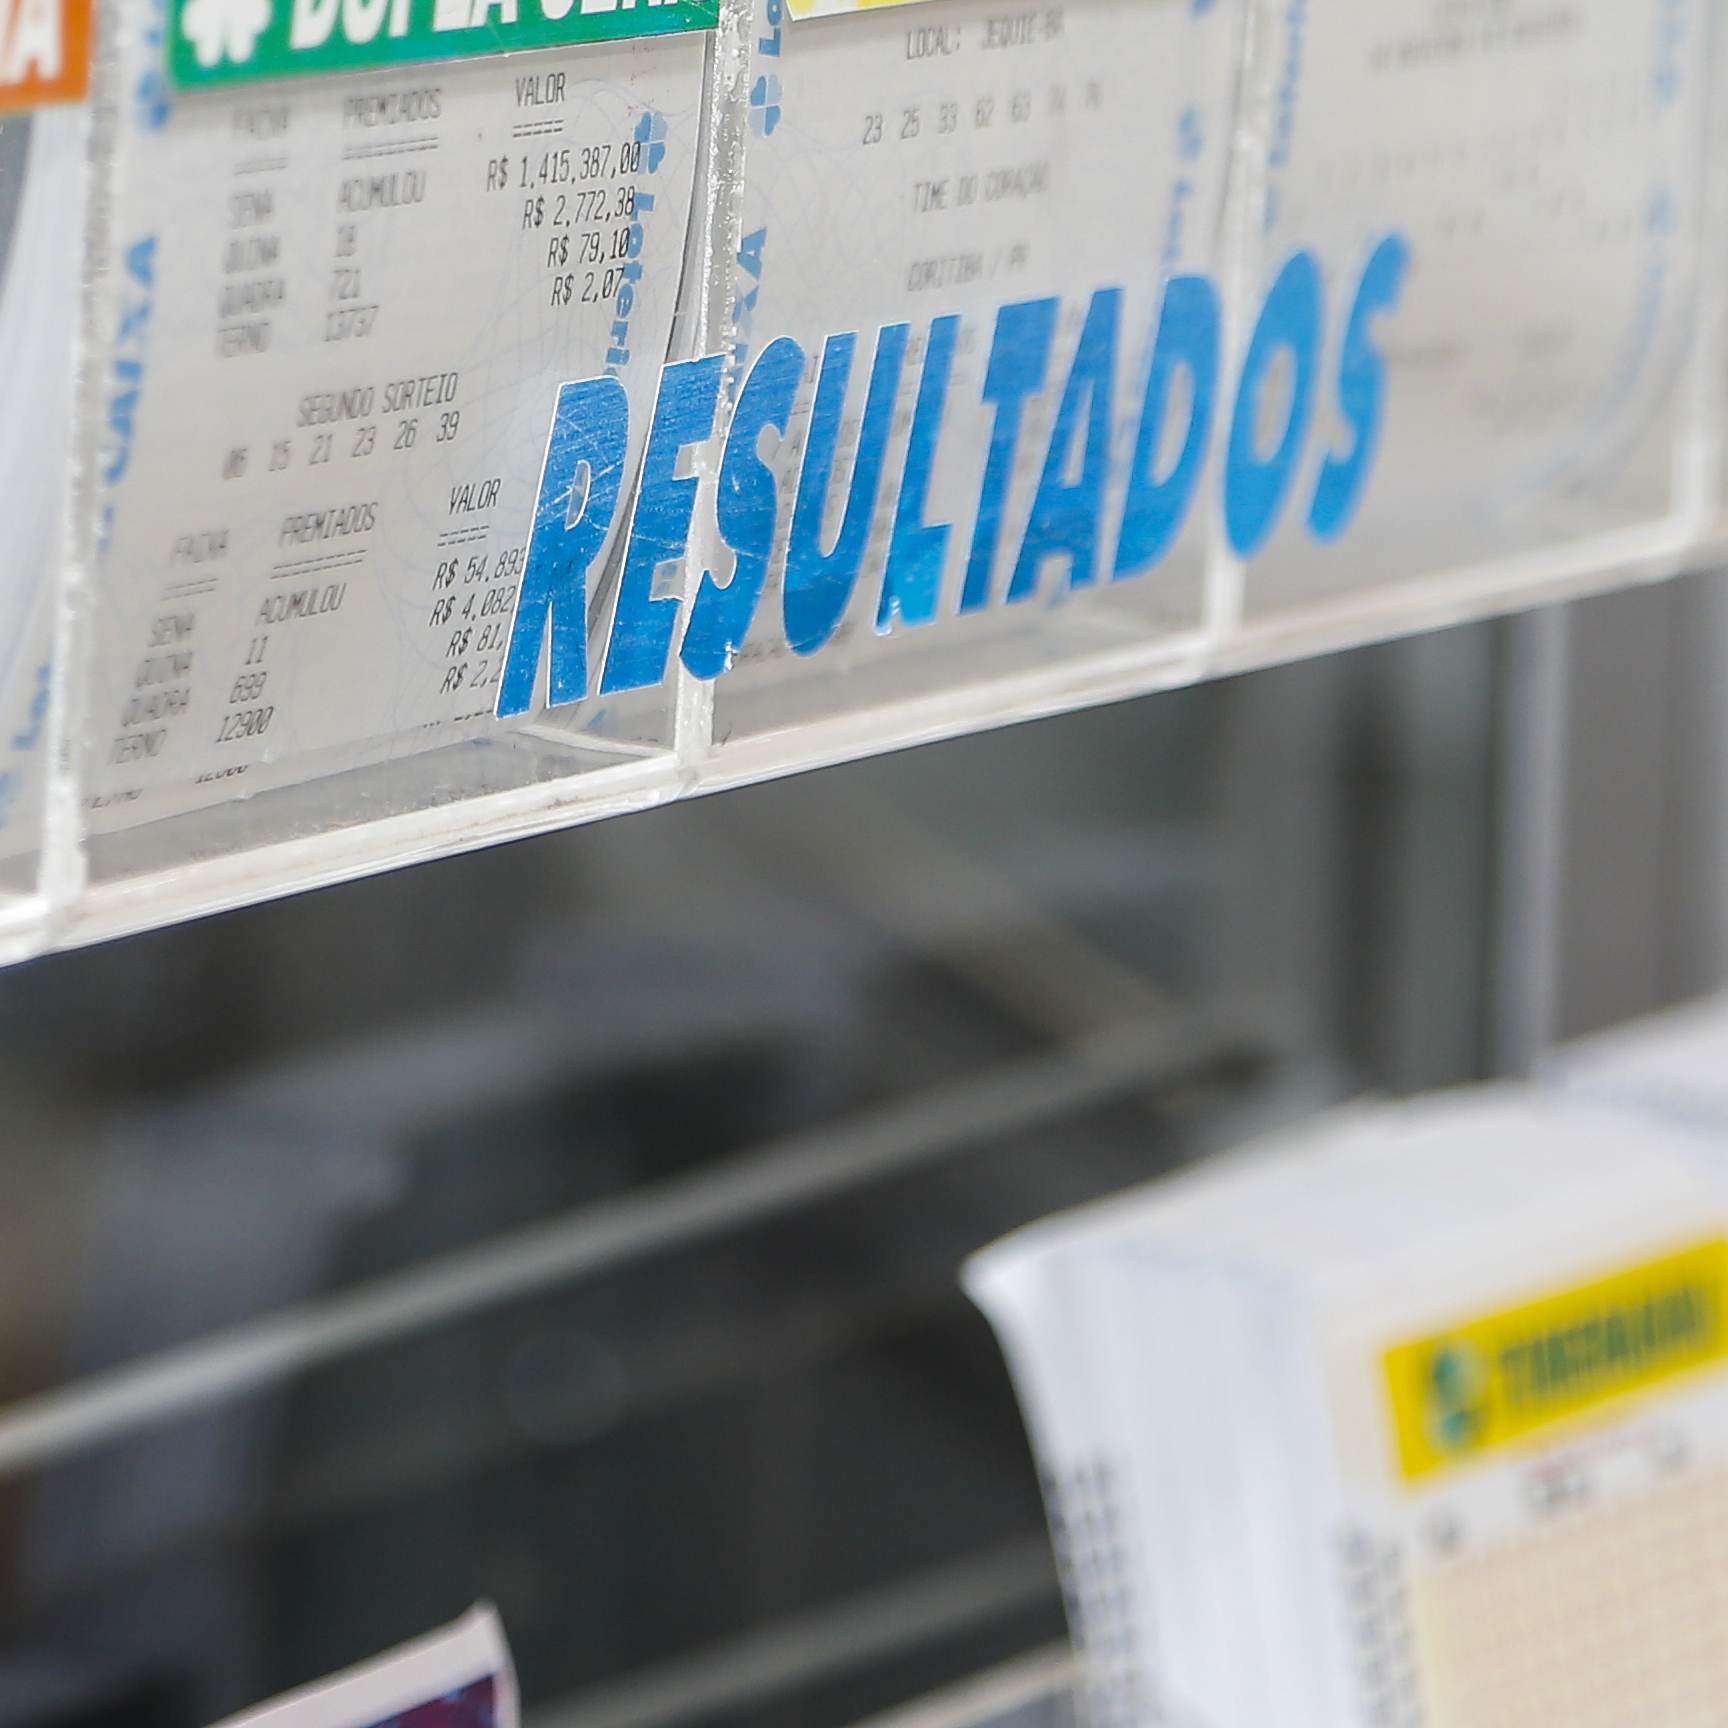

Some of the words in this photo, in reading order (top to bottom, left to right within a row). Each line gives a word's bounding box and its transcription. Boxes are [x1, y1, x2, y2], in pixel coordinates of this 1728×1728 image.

[906, 26, 962, 61] LOCAL:
[342, 86, 442, 131] PREMIADOS
[514, 73, 566, 107] VALOR
[862, 113, 884, 146] 23
[900, 107, 921, 140] 25
[337, 170, 427, 214] ACUMULOU
[486, 156, 508, 193] R$
[522, 196, 544, 231] R$
[552, 186, 636, 230] 2.772,38
[912, 180, 951, 213] TIME
[546, 235, 570, 269] R$
[579, 226, 629, 264] 79,10
[550, 272, 574, 307] R$
[581, 267, 625, 304] 2,07
[296, 385, 375, 428] SEGUNDO
[382, 372, 460, 415] SORTEIO
[308, 433, 333, 466] 21
[351, 425, 376, 458] 23
[393, 418, 419, 451] 26
[435, 410, 461, 443] 39
[492, 232, 1410, 720] RESULTADOS
[278, 501, 379, 547] PREMIADOS
[449, 478, 502, 516] VALOR
[255, 582, 347, 627] ACUMULOU
[432, 558, 458, 592] R$
[244, 635, 269, 666] 11
[428, 596, 453, 628] R$
[228, 671, 268, 704] 699
[446, 626, 469, 659] R$
[112, 728, 168, 765] TERNO
[214, 705, 275, 745] 12900
[439, 663, 465, 695] R$
